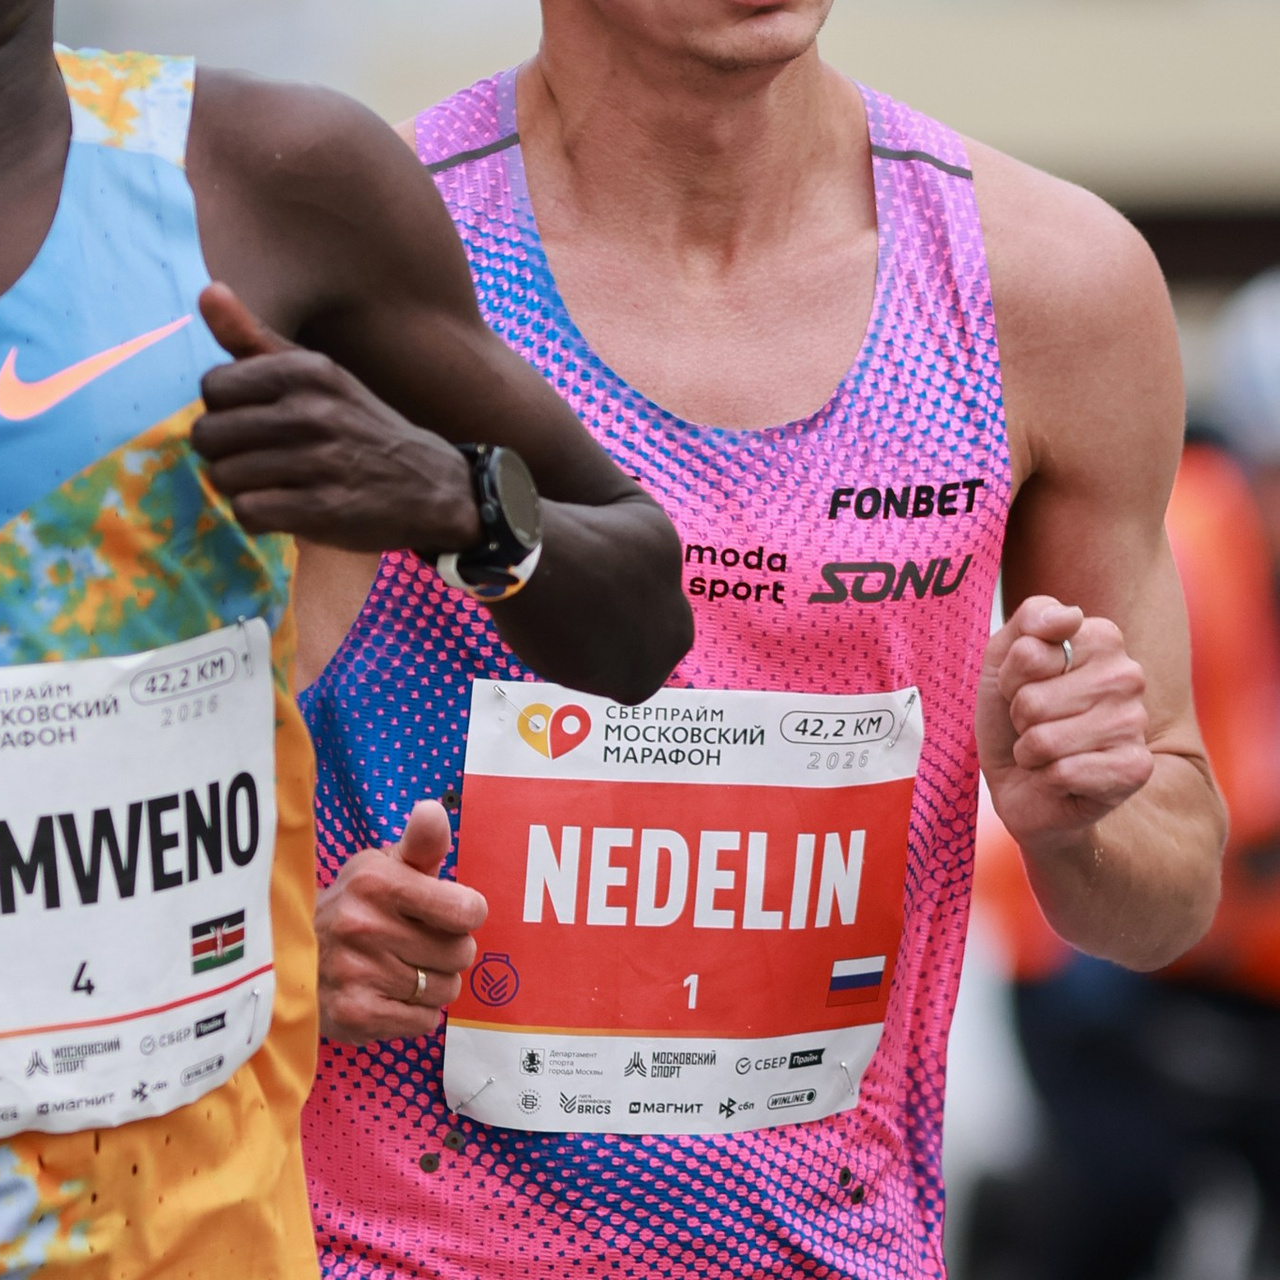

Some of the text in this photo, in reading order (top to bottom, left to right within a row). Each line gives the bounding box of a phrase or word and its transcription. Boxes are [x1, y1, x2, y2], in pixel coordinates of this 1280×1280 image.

[827, 478, 985, 520] FONBET
[808, 554, 974, 604] SONU
[688, 576, 785, 604] sport
[144, 667, 190, 695] 42,2
[162, 695, 218, 727] 2026
[606, 705, 724, 722] СБЕРПРАЙМ
[604, 723, 765, 746] МОСКОВСКИЙ
[794, 717, 845, 738] 42,2
[603, 746, 721, 767] МАРАФОН
[807, 750, 870, 770] 2026
[523, 824, 866, 930] NEDELIN
[72, 961, 95, 995] 4
[683, 973, 699, 1009] 1
[549, 1049, 597, 1059] Департамент
[549, 1059, 574, 1067] спорта
[651, 1049, 717, 1066] МОСКОВСКИЙ
[754, 1056, 788, 1071] СБЕР
[548, 1068, 604, 1076] города Москвы
[651, 1065, 682, 1078] СПОРТ
[577, 1104, 611, 1115] BRICS
[643, 1102, 704, 1113] магнит
[738, 1101, 755, 1111] сбп
[770, 1092, 807, 1107] WINLINE
